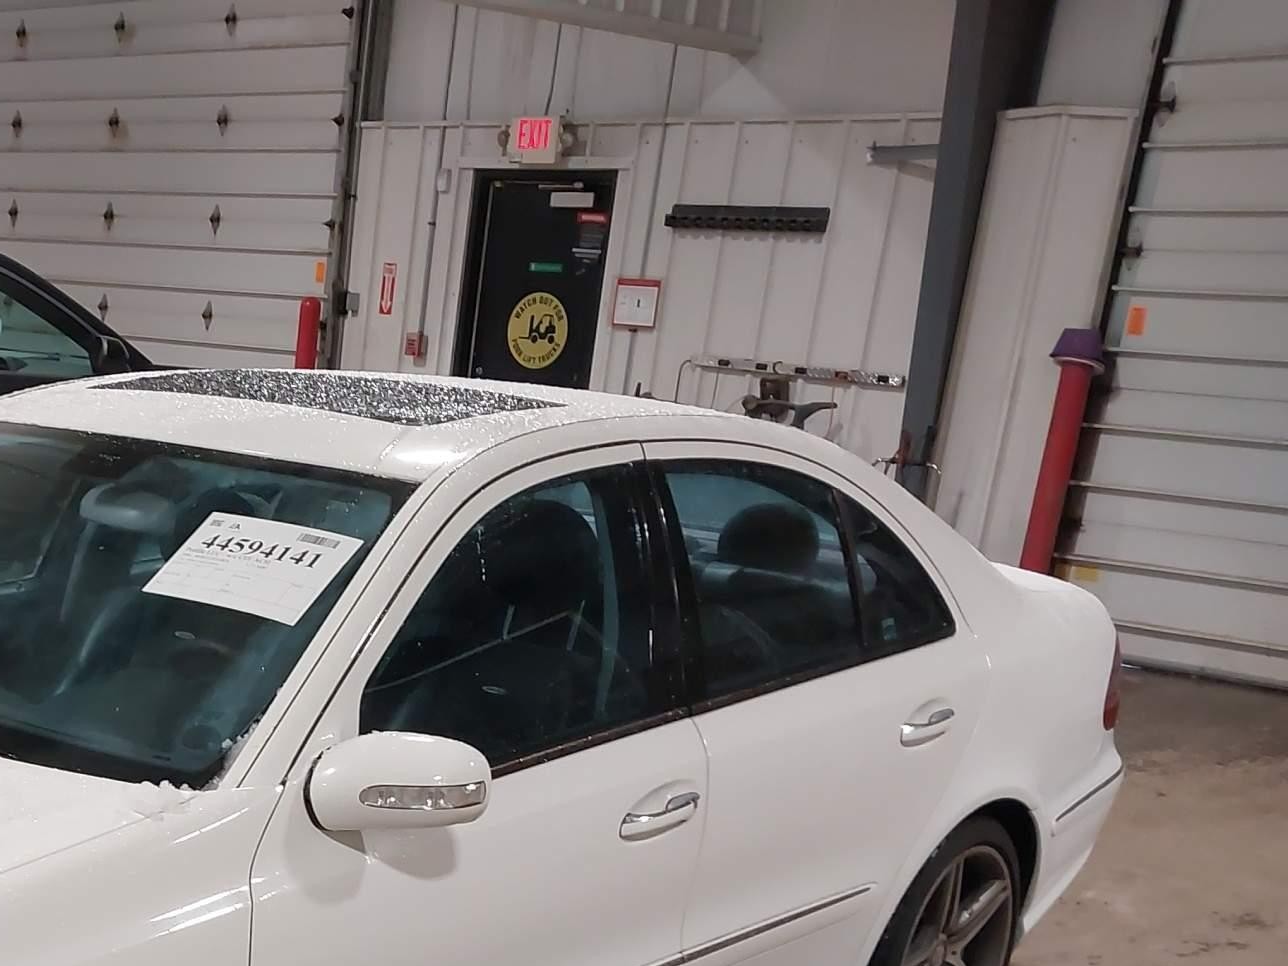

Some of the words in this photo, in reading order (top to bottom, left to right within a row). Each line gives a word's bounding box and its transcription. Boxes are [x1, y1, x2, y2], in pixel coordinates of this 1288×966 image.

[518, 119, 552, 150] EXIT
[514, 297, 537, 319] WATCH
[539, 295, 554, 307] OUT
[202, 534, 323, 569] 44594141
